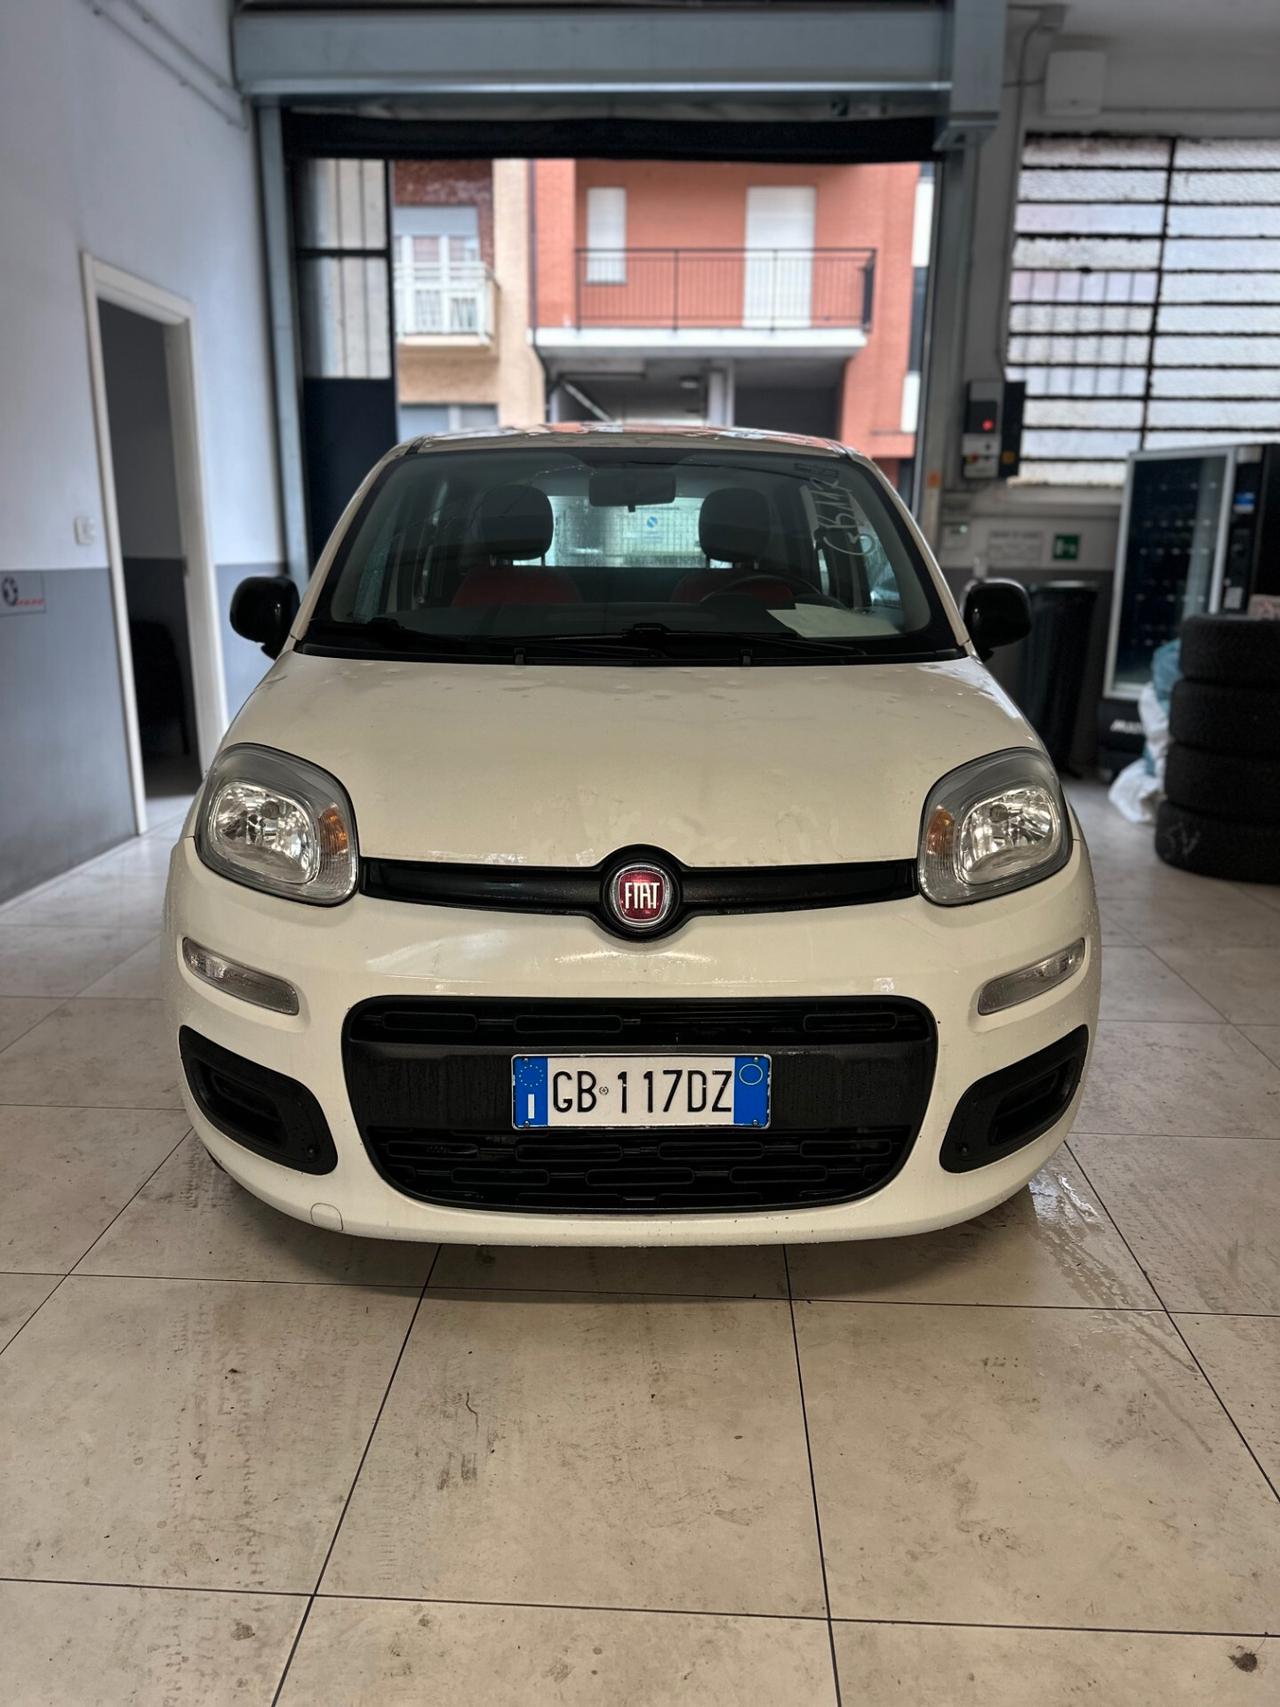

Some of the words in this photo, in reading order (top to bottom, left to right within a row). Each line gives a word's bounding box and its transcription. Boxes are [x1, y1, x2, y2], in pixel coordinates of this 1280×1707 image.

[625, 882, 660, 909] FIAT
[552, 1070, 597, 1113] GB
[617, 1069, 733, 1114] 117DZ
